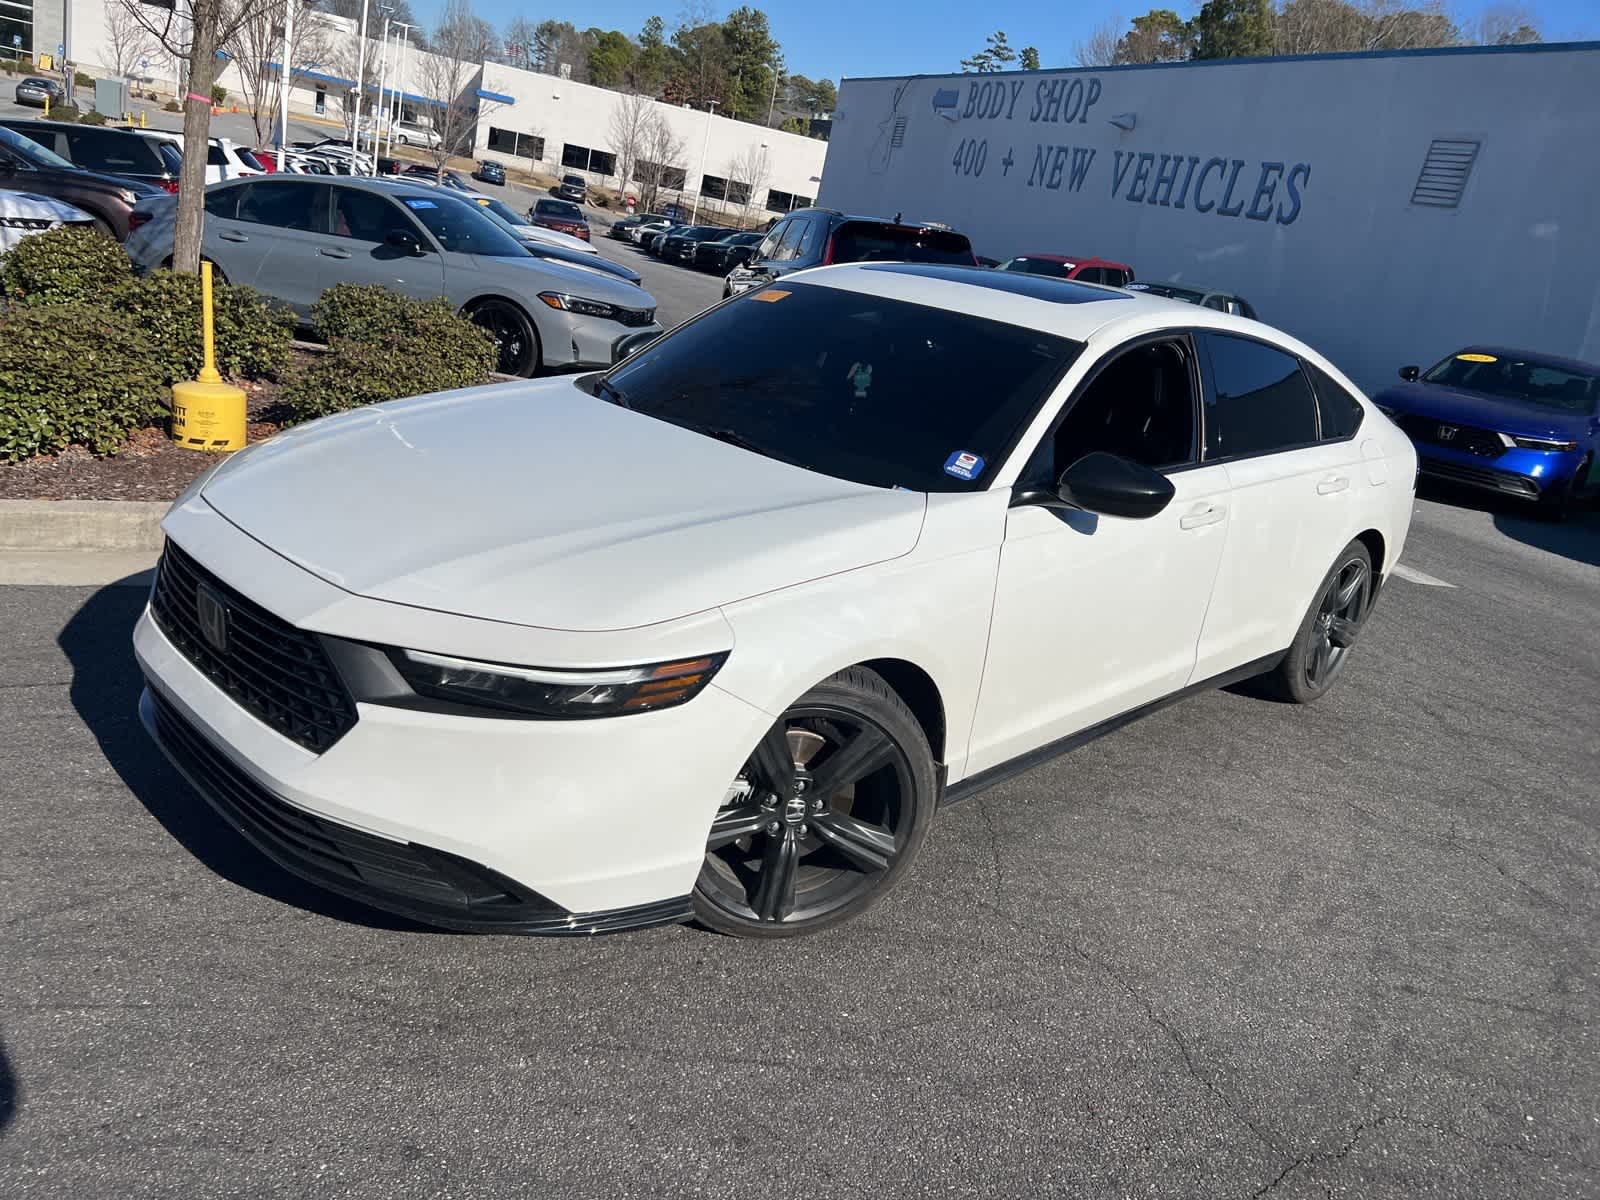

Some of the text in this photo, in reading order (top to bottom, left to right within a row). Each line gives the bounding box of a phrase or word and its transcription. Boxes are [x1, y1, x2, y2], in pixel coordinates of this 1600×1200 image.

[962, 77, 1102, 124] BODY SHOP
[953, 137, 1311, 225] 400 + NEW VEHICLES
